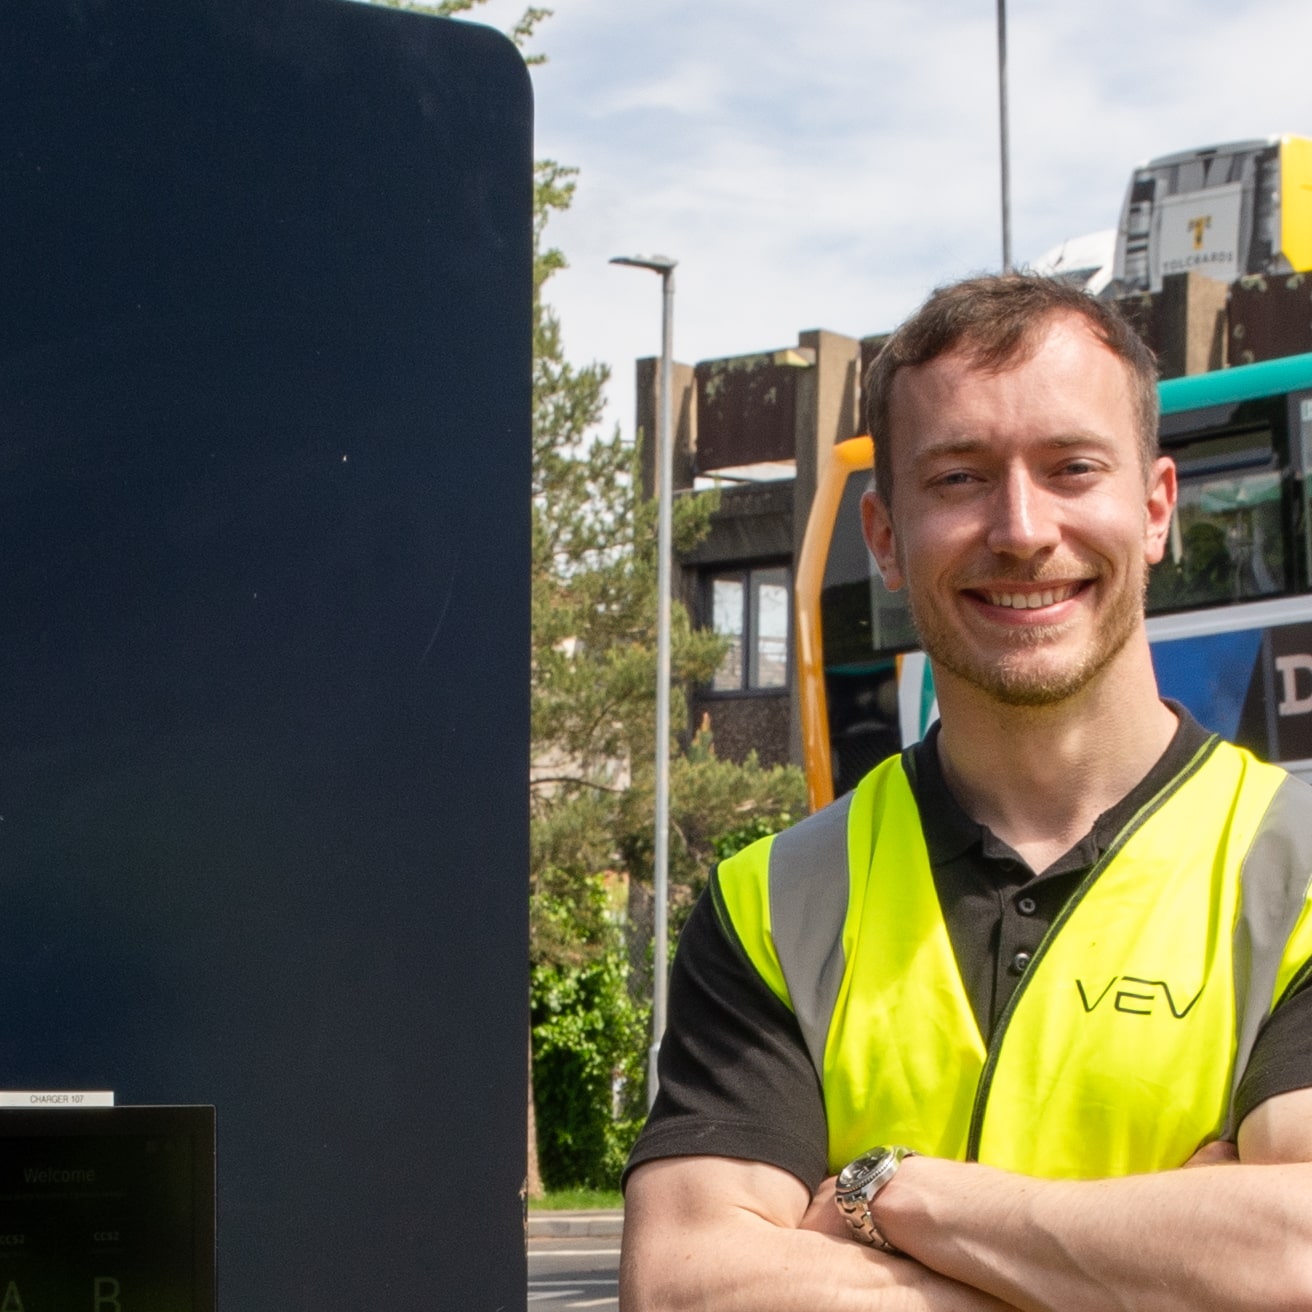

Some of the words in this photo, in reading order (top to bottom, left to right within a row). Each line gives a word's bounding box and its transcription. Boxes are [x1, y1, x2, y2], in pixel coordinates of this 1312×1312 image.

[1075, 975, 1207, 1019] VEV
[30, 1094, 69, 1104] CHARGER
[71, 1094, 85, 1104] 107
[23, 1167, 96, 1184] Welcome
[93, 1231, 121, 1241] CCS2
